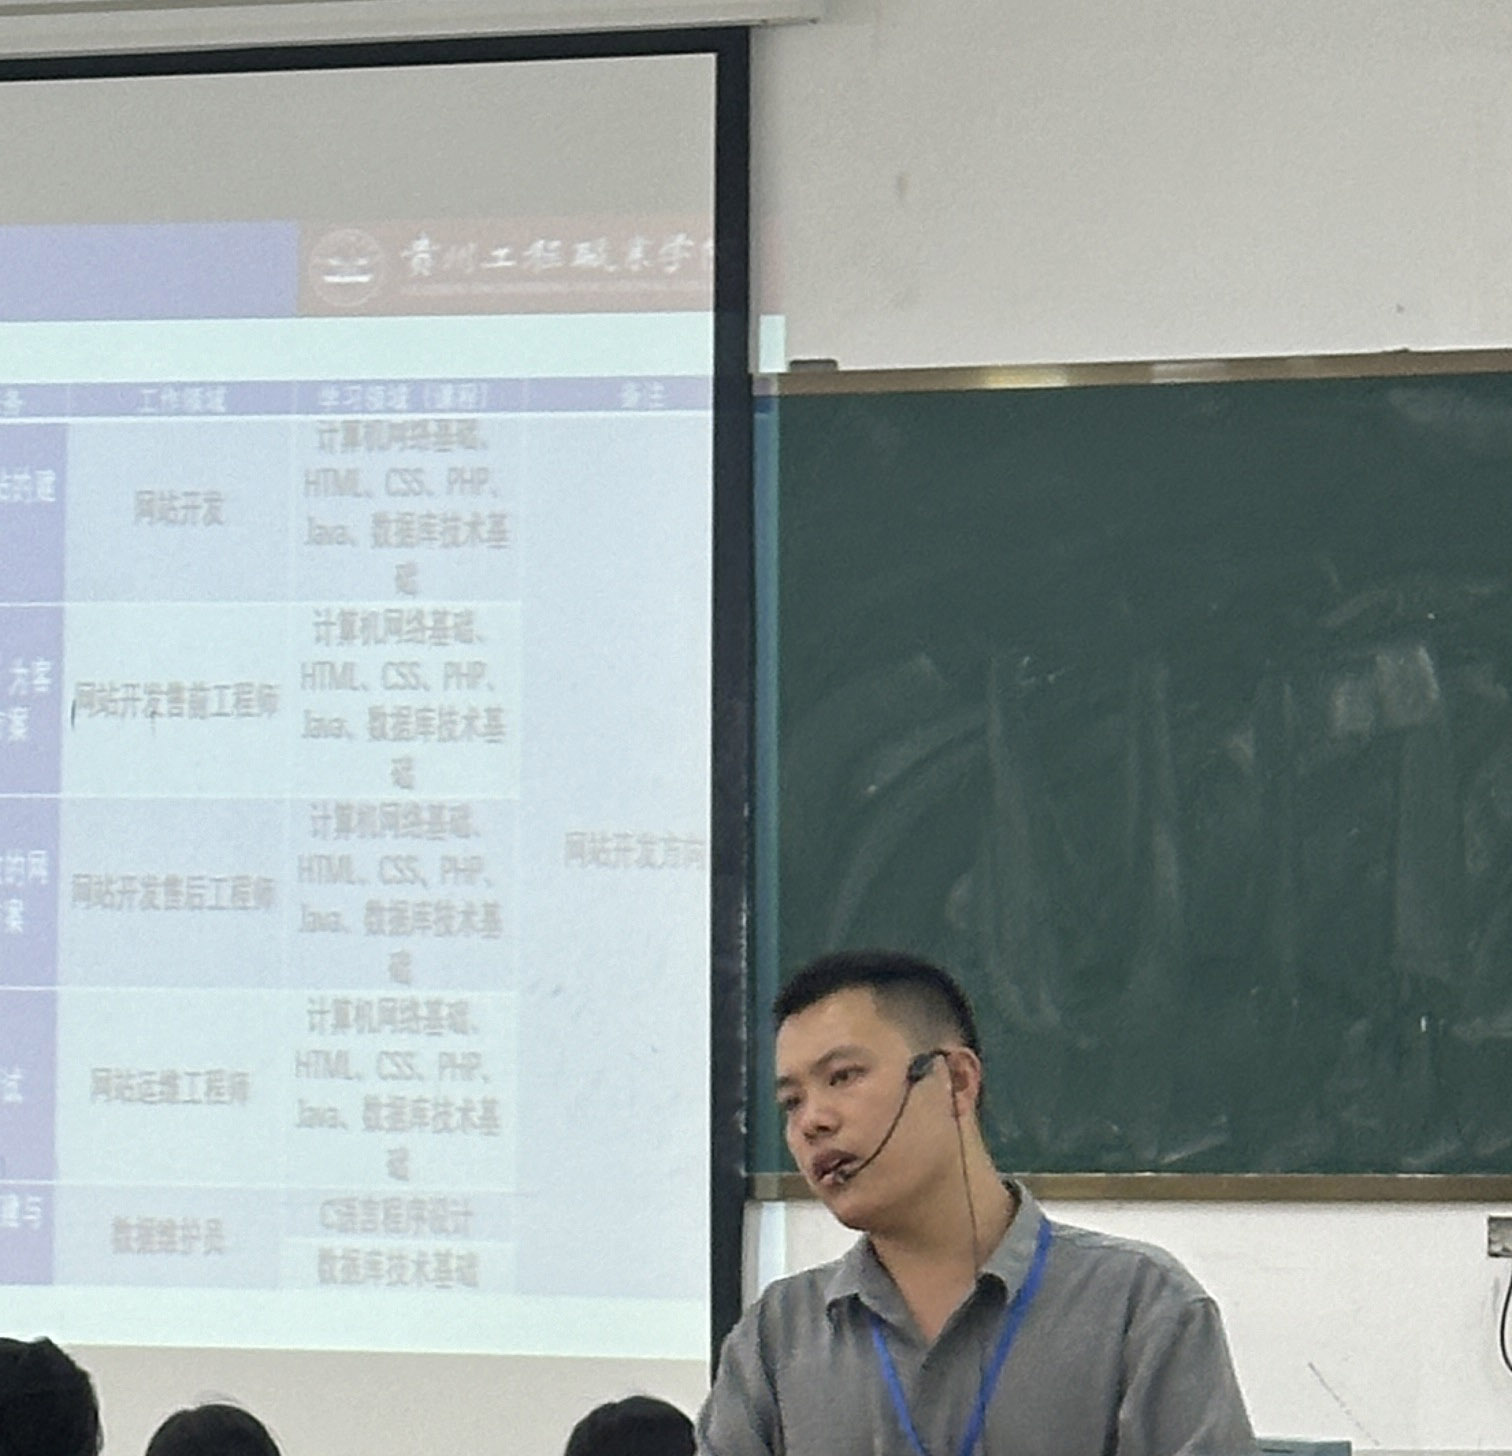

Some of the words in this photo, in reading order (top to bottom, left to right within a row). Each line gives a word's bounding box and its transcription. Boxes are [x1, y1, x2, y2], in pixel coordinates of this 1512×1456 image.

[133, 489, 227, 527] 网站开发
[300, 704, 507, 744] Java、数据库技术基
[297, 899, 504, 940] Java、数据库技术基
[90, 1066, 250, 1107] 网站运维工程师
[294, 1095, 501, 1137] Java、数据库技术基
